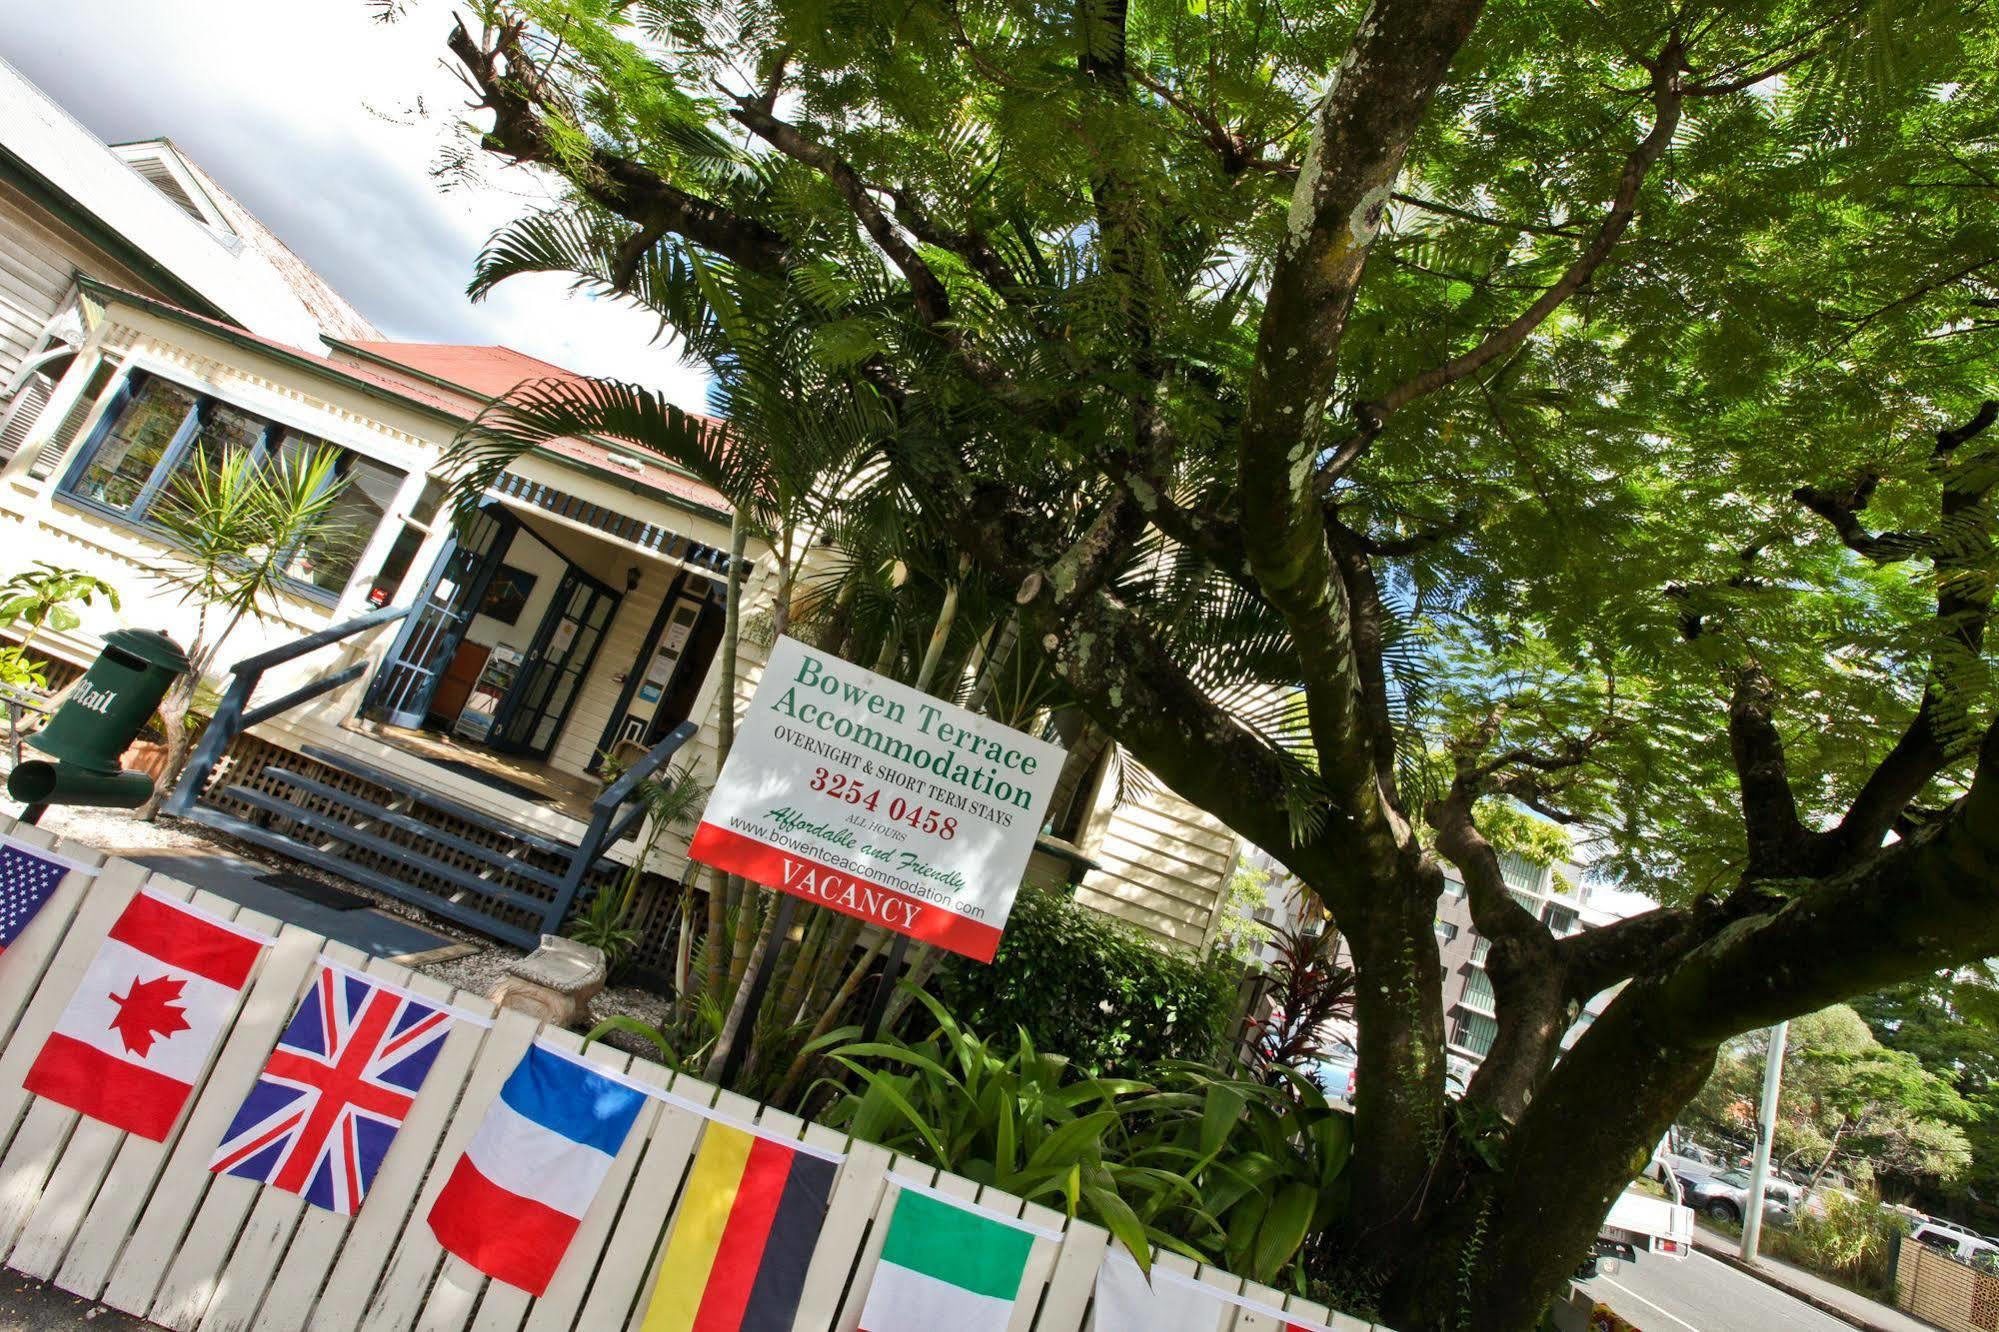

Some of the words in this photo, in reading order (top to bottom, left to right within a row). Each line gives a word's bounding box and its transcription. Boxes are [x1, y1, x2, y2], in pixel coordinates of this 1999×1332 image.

[72, 678, 117, 714] Mail
[793, 655, 906, 724] Bowen
[917, 704, 1037, 775] Terrace
[771, 686, 1032, 811] Accommodation
[774, 725, 862, 769] OVERNIGHT
[863, 760, 874, 775] &
[876, 765, 926, 793] SHORT
[929, 784, 968, 811] TERM
[968, 801, 1013, 827] STAYS
[810, 767, 881, 812] 3254
[889, 797, 958, 840] 0458
[845, 814, 868, 829] ALL
[869, 821, 907, 842] HOURS
[730, 816, 985, 919] www.bowentceaccommodation.com
[763, 807, 857, 848] Affordable
[861, 844, 897, 863] and
[896, 852, 965, 893] Friendly
[783, 858, 921, 929] VACANCY
